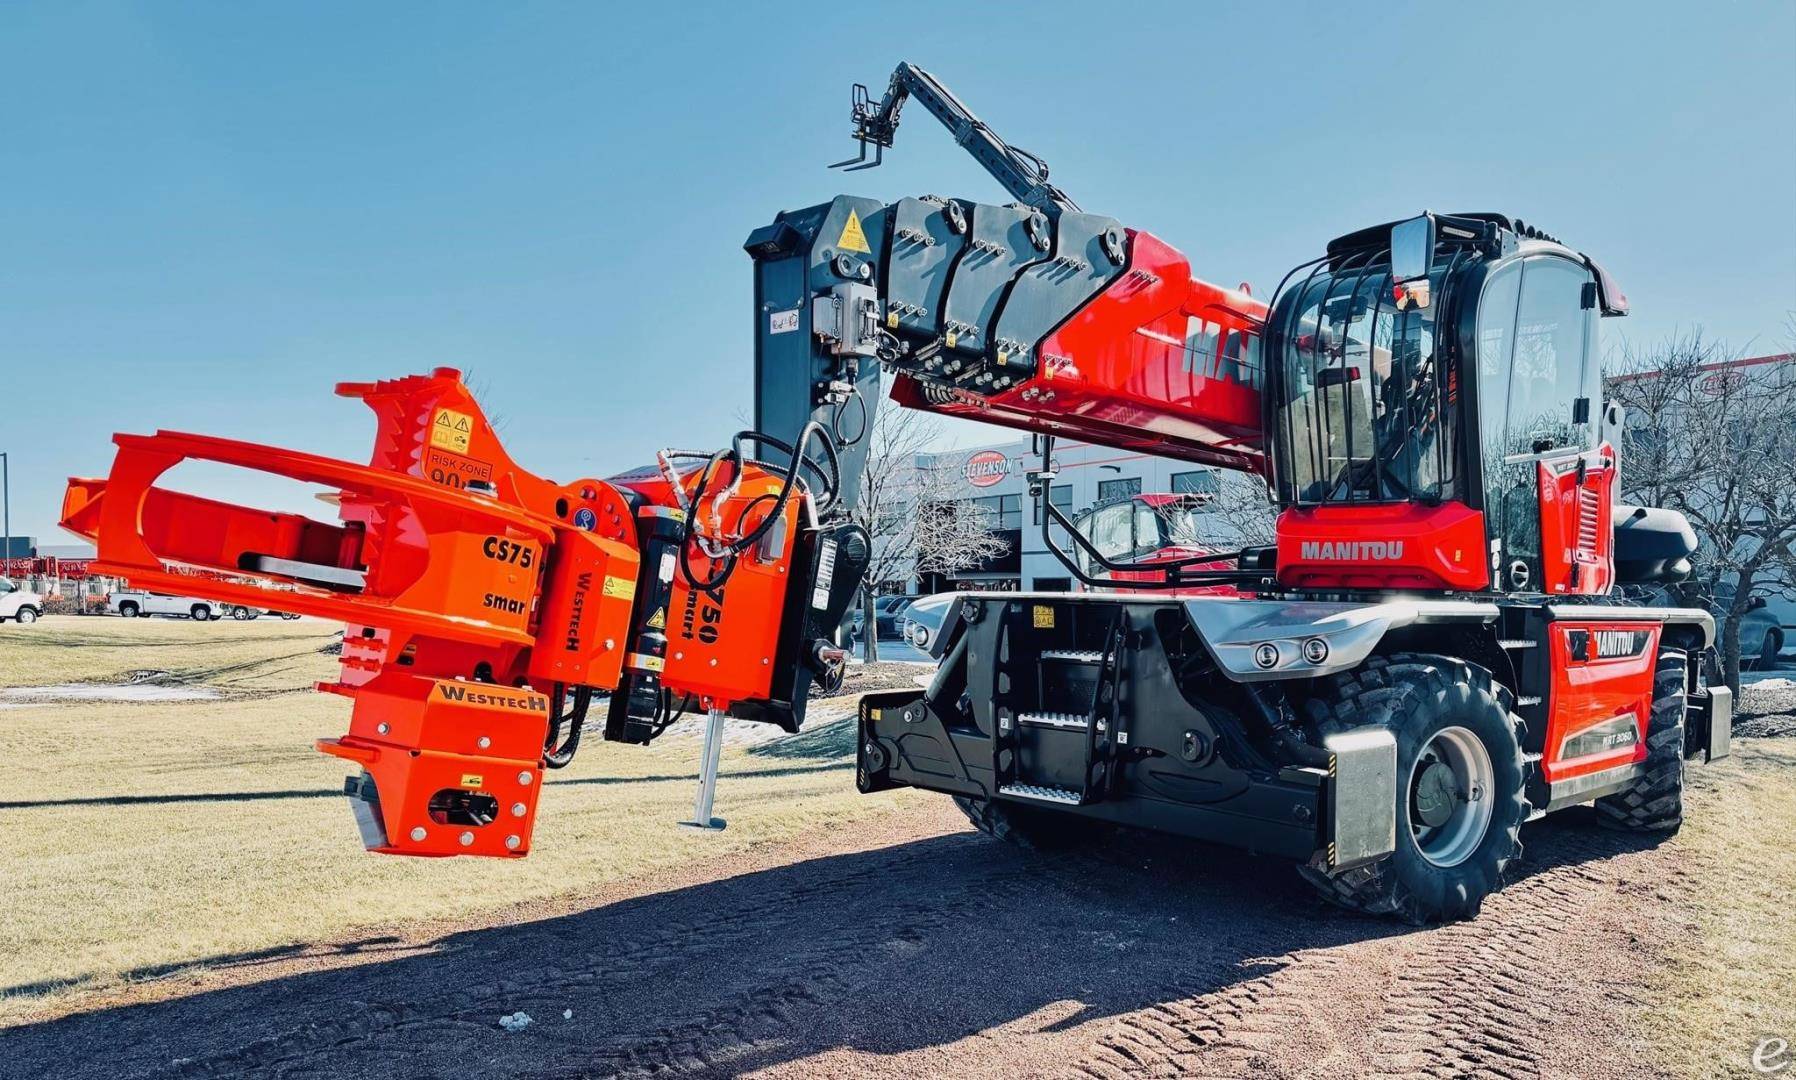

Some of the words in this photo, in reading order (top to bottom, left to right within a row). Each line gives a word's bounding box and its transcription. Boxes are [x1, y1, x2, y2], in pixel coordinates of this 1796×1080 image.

[432, 454, 457, 469] RISK
[460, 461, 489, 478] ZONE
[961, 458, 1013, 479] STEVENSON
[483, 536, 532, 568] CS75
[1301, 541, 1403, 560] MANITOU
